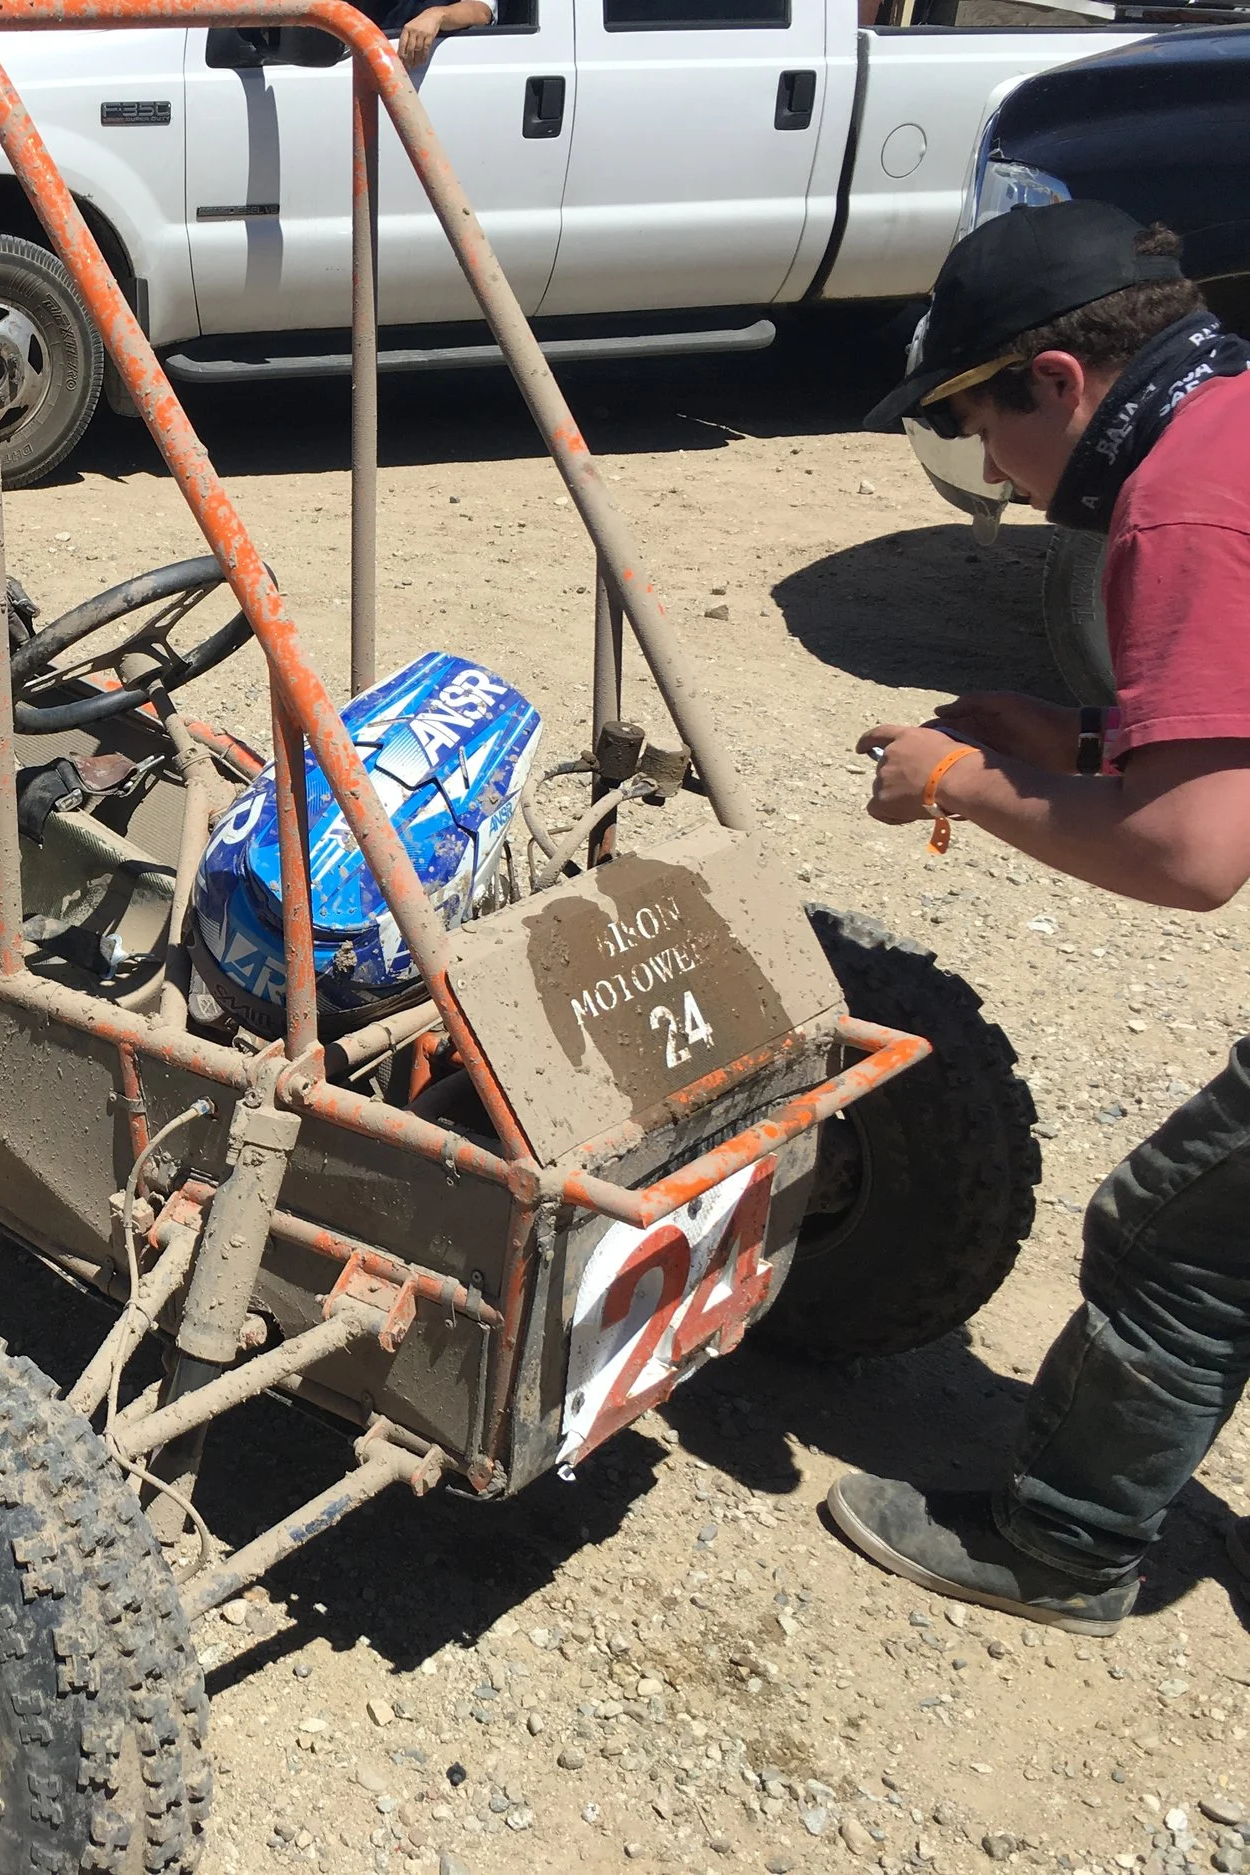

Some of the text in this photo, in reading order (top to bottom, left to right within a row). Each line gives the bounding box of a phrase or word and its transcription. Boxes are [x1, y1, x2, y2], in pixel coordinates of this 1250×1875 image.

[412, 668, 508, 767] ANSR
[489, 802, 514, 838] ANSR
[650, 991, 714, 1069] 24
[572, 1153, 778, 1467] 24
